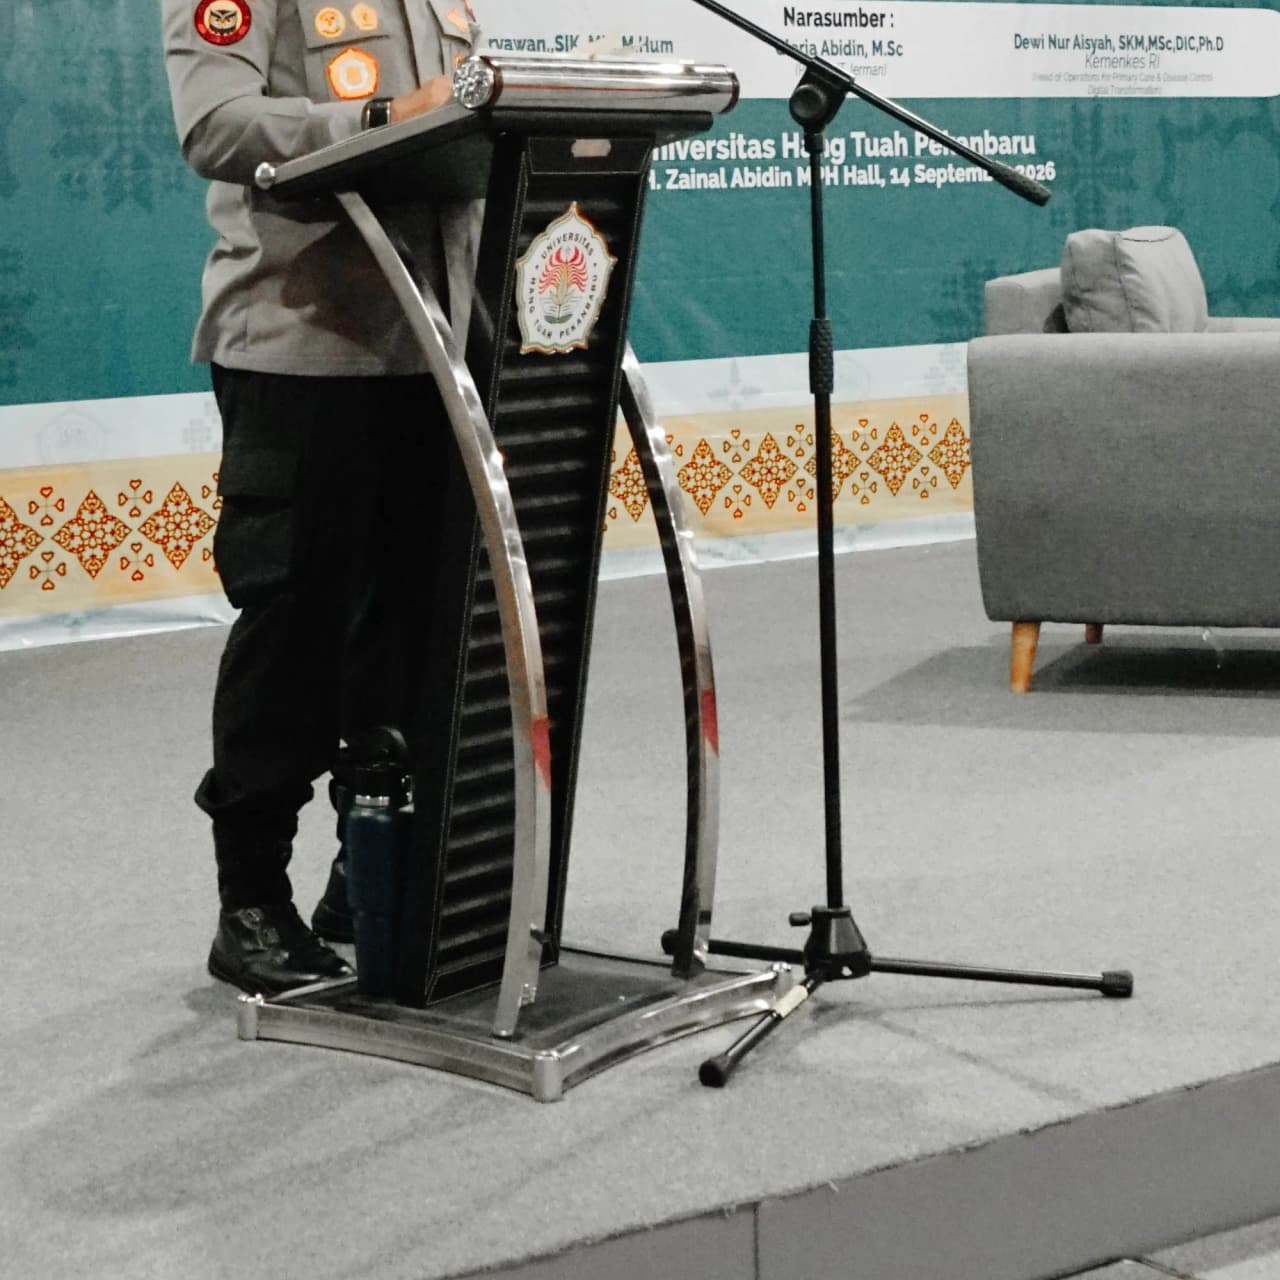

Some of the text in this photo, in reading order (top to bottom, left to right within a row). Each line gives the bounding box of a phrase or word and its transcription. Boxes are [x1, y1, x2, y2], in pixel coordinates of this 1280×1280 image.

[783, 6, 886, 27] Narasumber
[821, 40, 868, 58] Abidin,
[872, 40, 903, 56] M.Sc
[1014, 34, 1045, 50] Dewi
[1049, 35, 1070, 51] Nur
[1073, 34, 1116, 55] Aisyah,
[1085, 53, 1145, 70] Kemenkes
[652, 132, 776, 161] niversitas
[850, 131, 910, 157] Tuah
[666, 168, 727, 190] Zainal
[730, 166, 792, 189] Abidin
[843, 165, 886, 188] Hall,
[889, 169, 910, 187] 14
[541, 232, 593, 259] UNIVERSITAS
[528, 277, 537, 314] HANG
